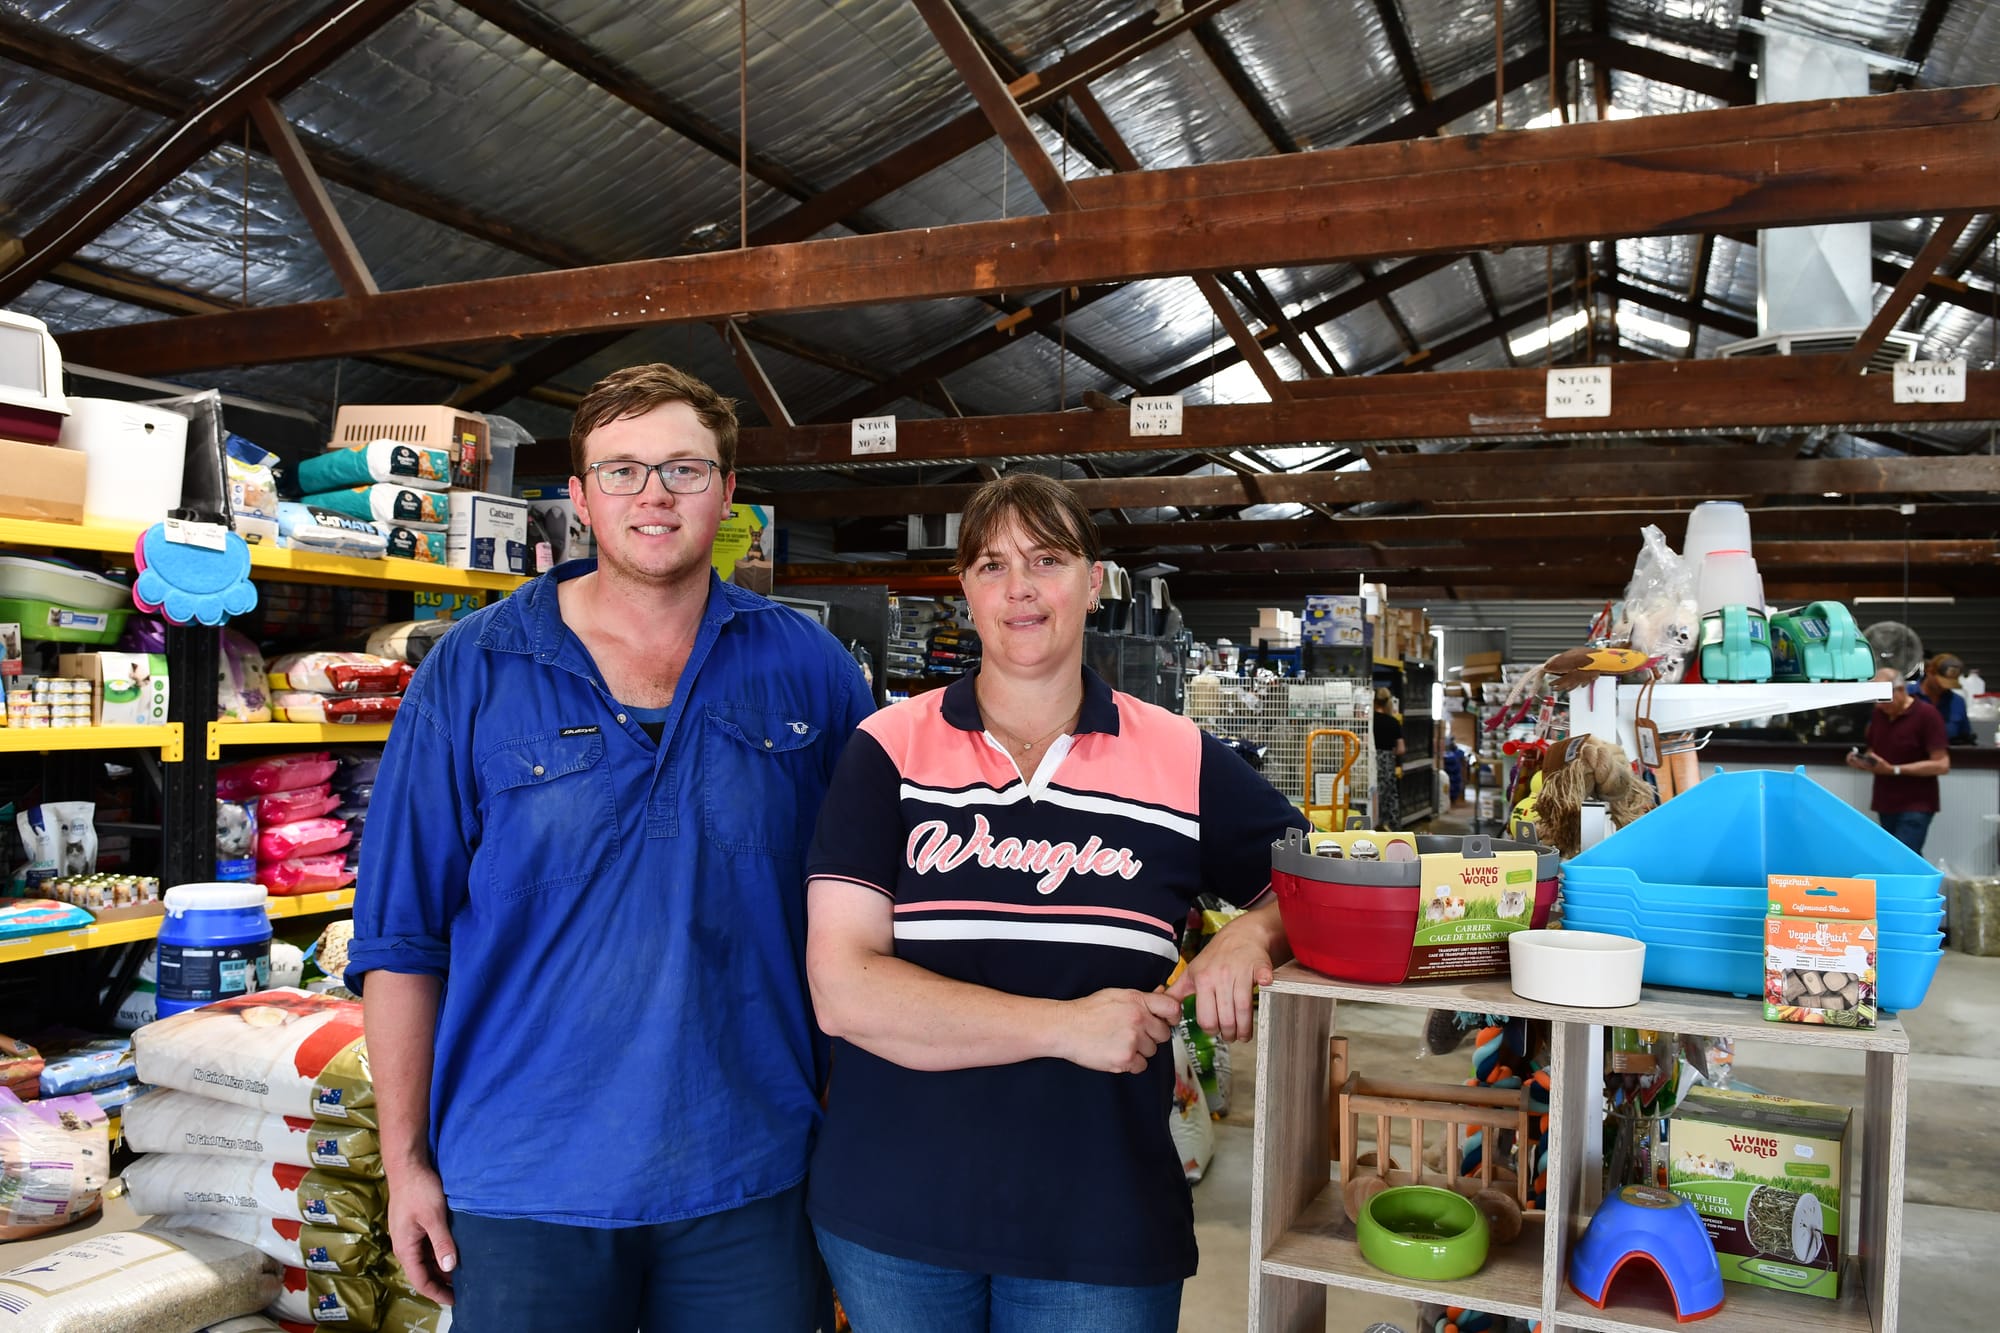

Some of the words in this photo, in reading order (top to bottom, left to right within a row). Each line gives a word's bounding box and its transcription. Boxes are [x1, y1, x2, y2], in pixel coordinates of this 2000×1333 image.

[1907, 366, 1957, 376] STACK
[1557, 375, 1602, 386] STACK
[1906, 386, 1925, 395] NO
[1555, 396, 1572, 405] NO
[1584, 393, 1595, 405] 5
[1136, 401, 1173, 411] STACK
[857, 421, 890, 432] STACK
[1136, 421, 1150, 430] NO
[857, 440, 871, 448] NO
[879, 435, 886, 446] 2
[906, 813, 1142, 894] Wrangler
[1465, 866, 1499, 876] LIVING
[1459, 872, 1498, 887] WORLD
[1770, 903, 1781, 911] 20
[1455, 923, 1492, 933] CARRIER
[1429, 933, 1452, 943] CAGE
[1453, 932, 1464, 941] DE
[120, 1010, 138, 1024] ussy
[194, 1068, 204, 1081] No
[205, 1070, 224, 1085] Grind
[224, 1074, 244, 1089] Micro
[244, 1079, 269, 1095] Pellets
[1733, 1134, 1778, 1148] LIVING
[1725, 1138, 1778, 1158] WORLD
[1695, 1193, 1730, 1206] WHEEL
[1709, 1204, 1733, 1216] FOIN
